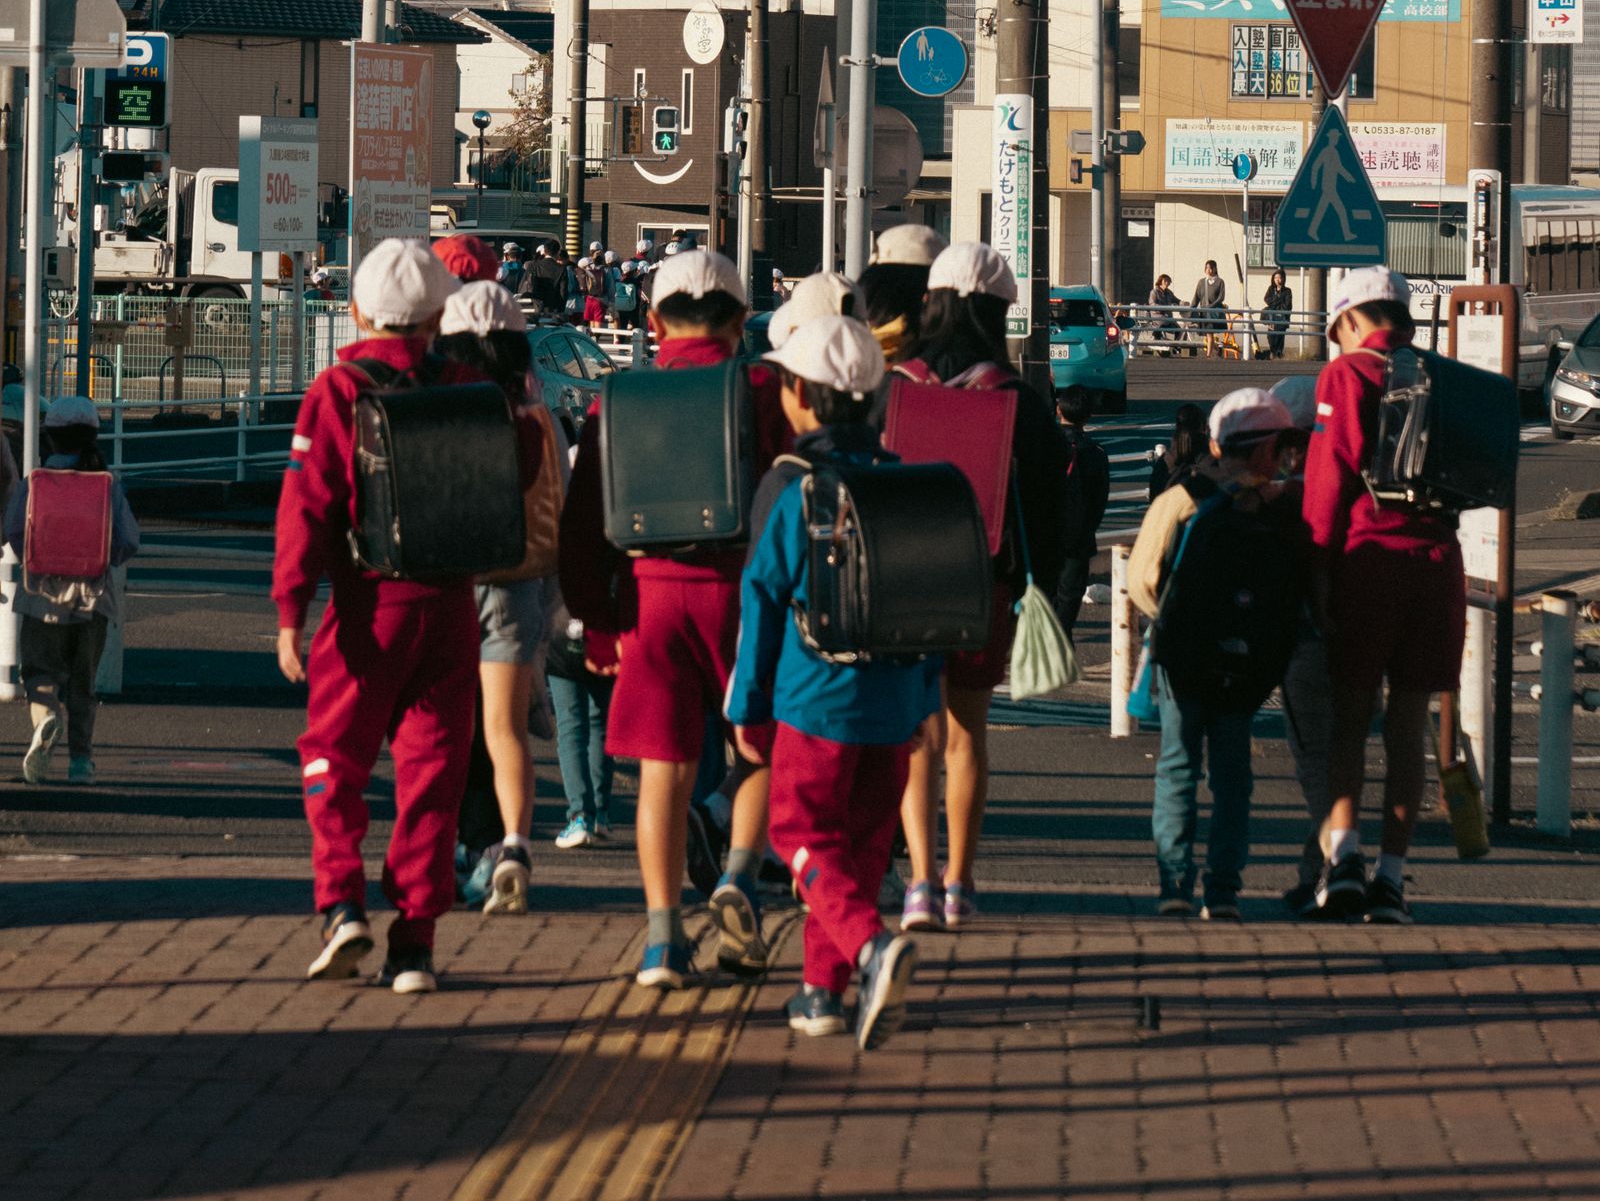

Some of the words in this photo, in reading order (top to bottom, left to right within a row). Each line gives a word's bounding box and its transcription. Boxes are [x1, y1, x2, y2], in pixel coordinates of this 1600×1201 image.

[1404, 4, 1448, 16] 高校部
[1234, 28, 1300, 48] 入塾直前
[126, 39, 153, 65] P
[1234, 51, 1313, 70] 入塾後11
[133, 66, 158, 78] 24H
[118, 86, 152, 121] 空
[357, 85, 413, 131] 塗装専門店
[1371, 126, 1436, 135] 0533-87-0187
[1172, 146, 1278, 168] 国語速解
[1283, 140, 1297, 169] 講座
[1360, 150, 1422, 171] 速読聴
[1426, 143, 1440, 172] 講座
[266, 173, 297, 205] 500円
